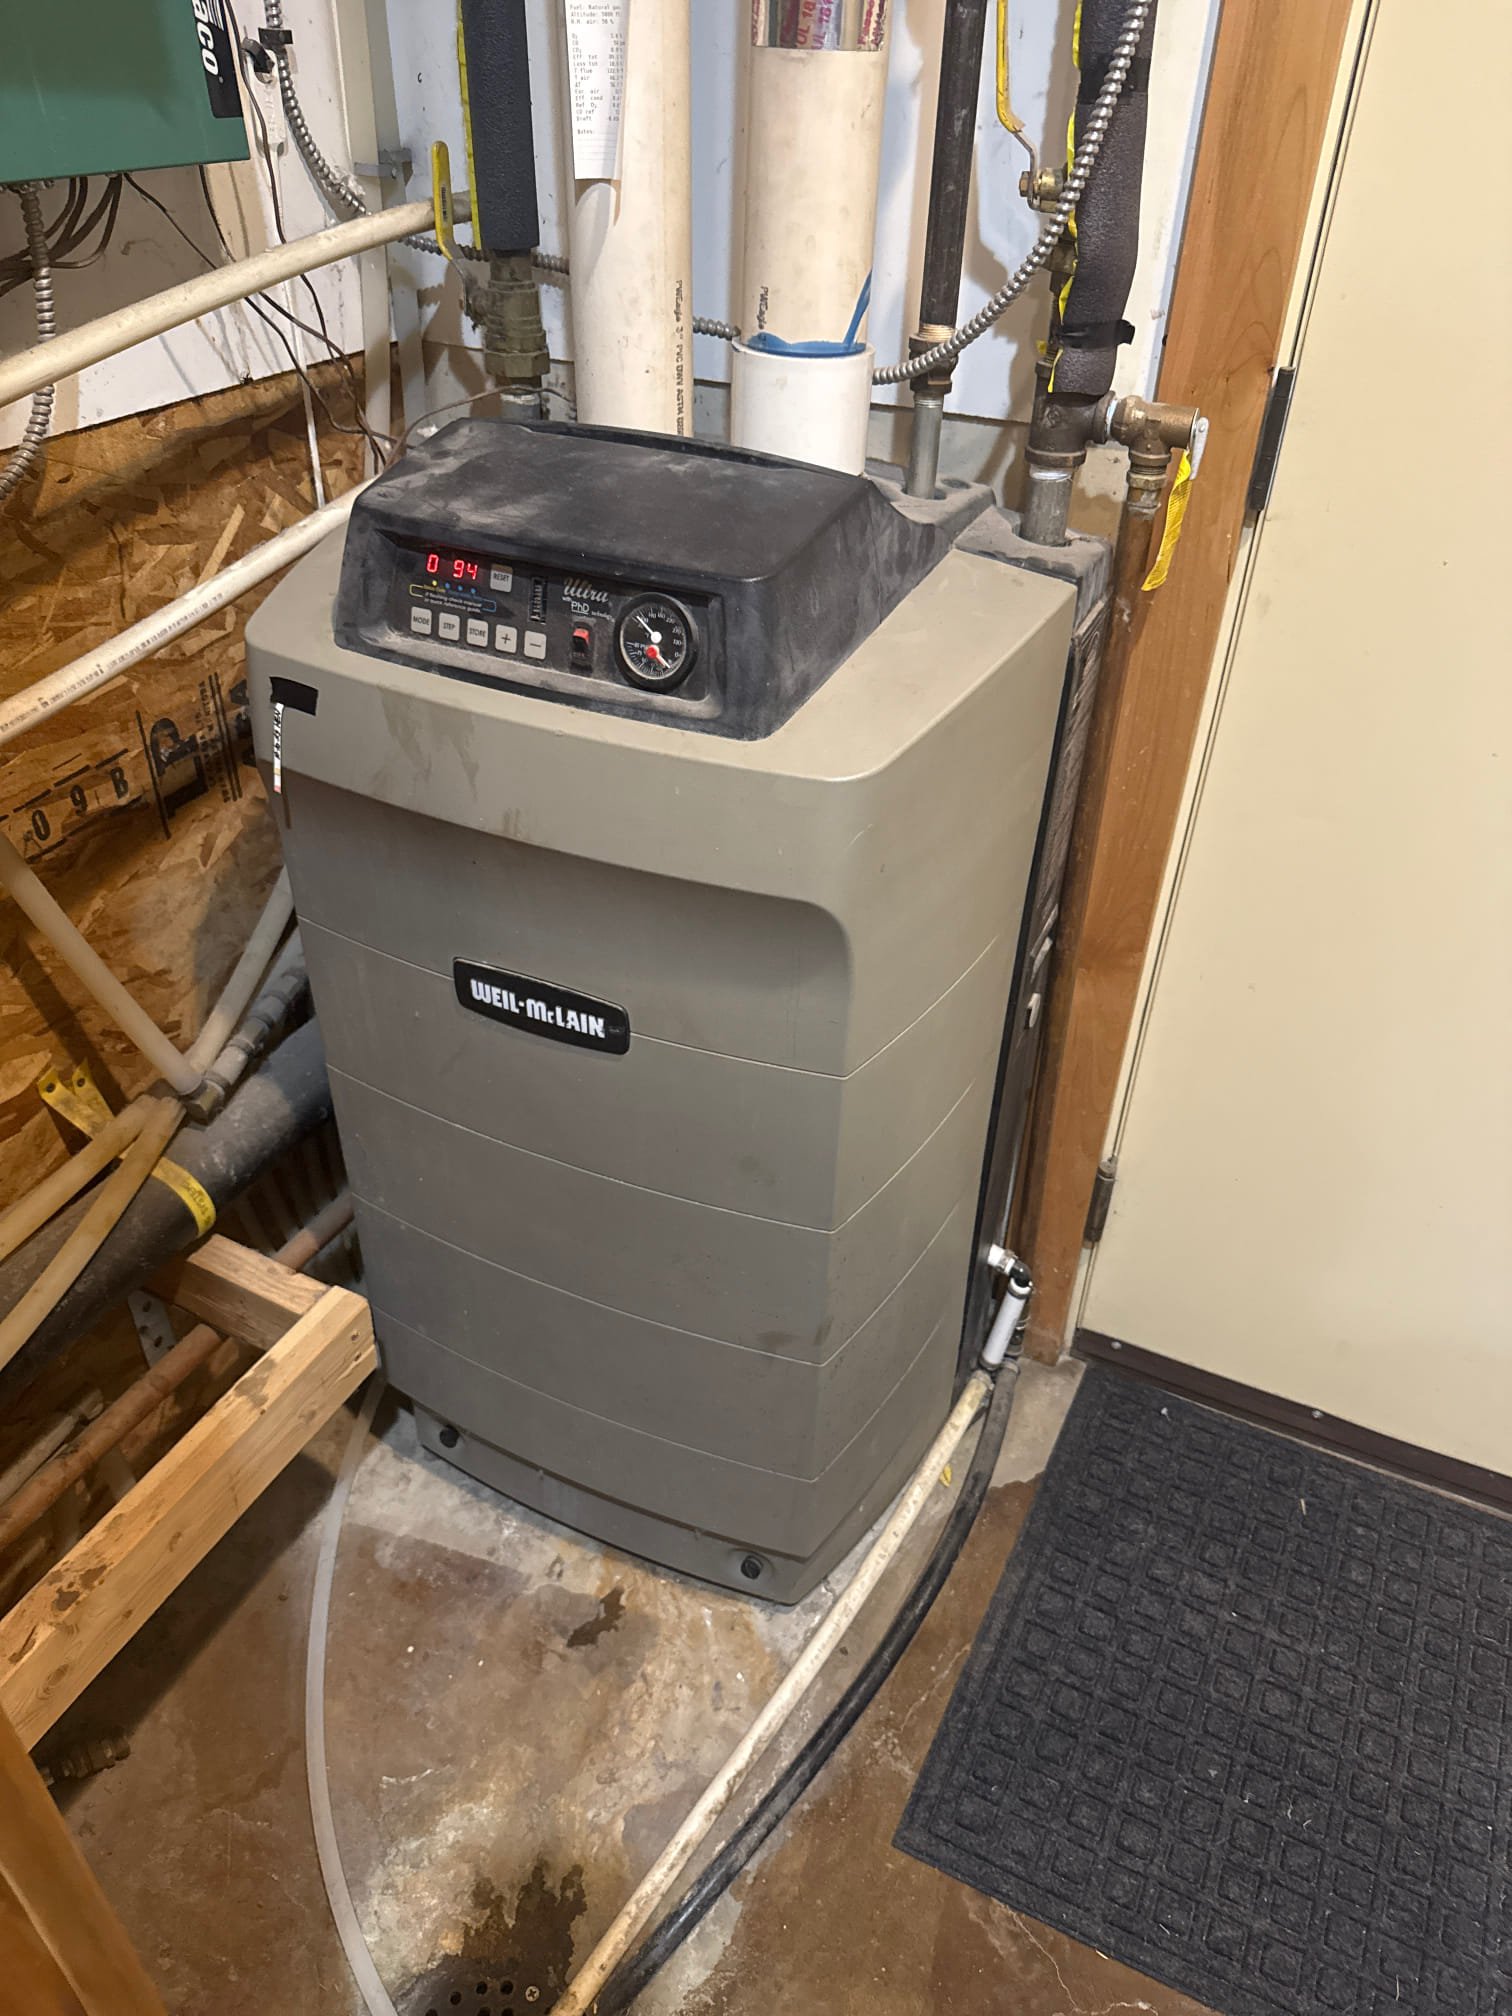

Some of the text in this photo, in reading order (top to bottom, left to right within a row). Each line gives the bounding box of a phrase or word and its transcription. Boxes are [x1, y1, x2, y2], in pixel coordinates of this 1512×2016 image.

[676, 344, 684, 363] PVC
[676, 388, 684, 416] ASTM
[453, 560, 478, 580] 94
[493, 573, 510, 583] RESET
[563, 577, 609, 603] Ultra
[571, 601, 590, 612] PhD
[413, 615, 430, 626] MODE
[443, 622, 456, 631] STEP
[469, 627, 487, 638] STORE
[470, 978, 606, 1039] WEIL-McLAIN
